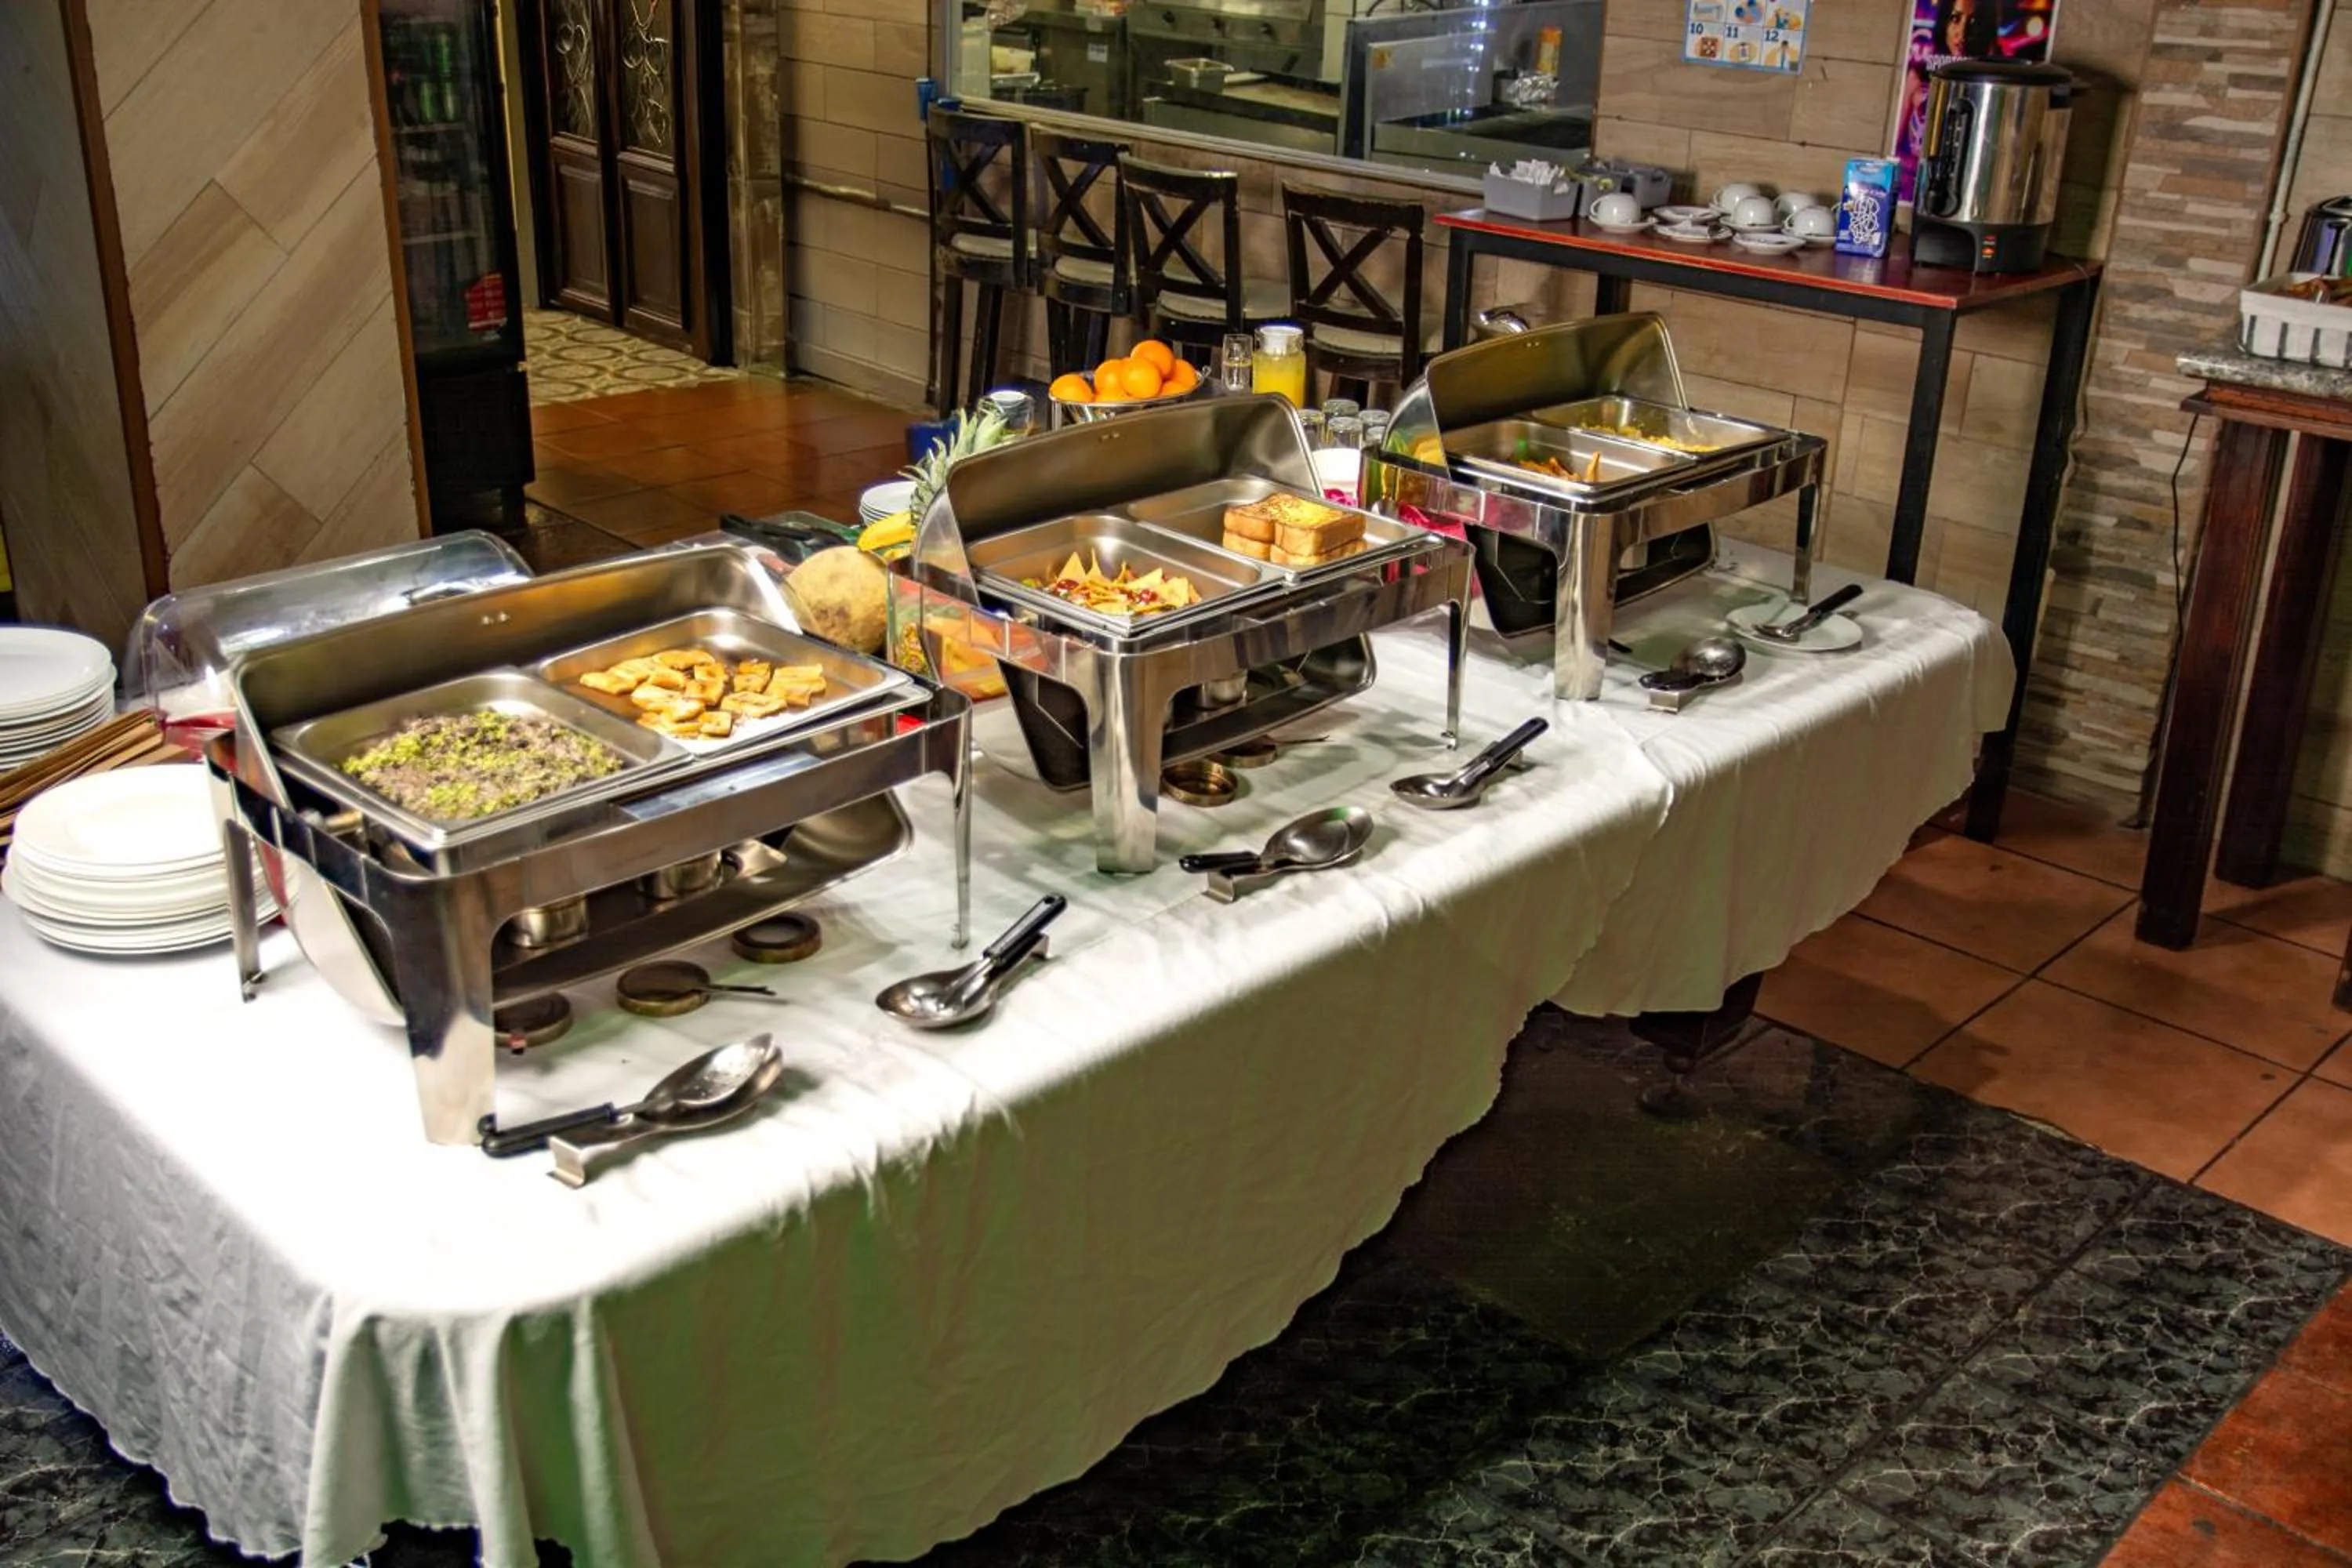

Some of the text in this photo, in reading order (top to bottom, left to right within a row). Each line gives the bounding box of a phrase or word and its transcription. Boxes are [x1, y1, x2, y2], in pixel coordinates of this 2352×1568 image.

[1690, 23, 1704, 34] 10
[1727, 26, 1738, 38] 11
[1765, 30, 1779, 42] 12
